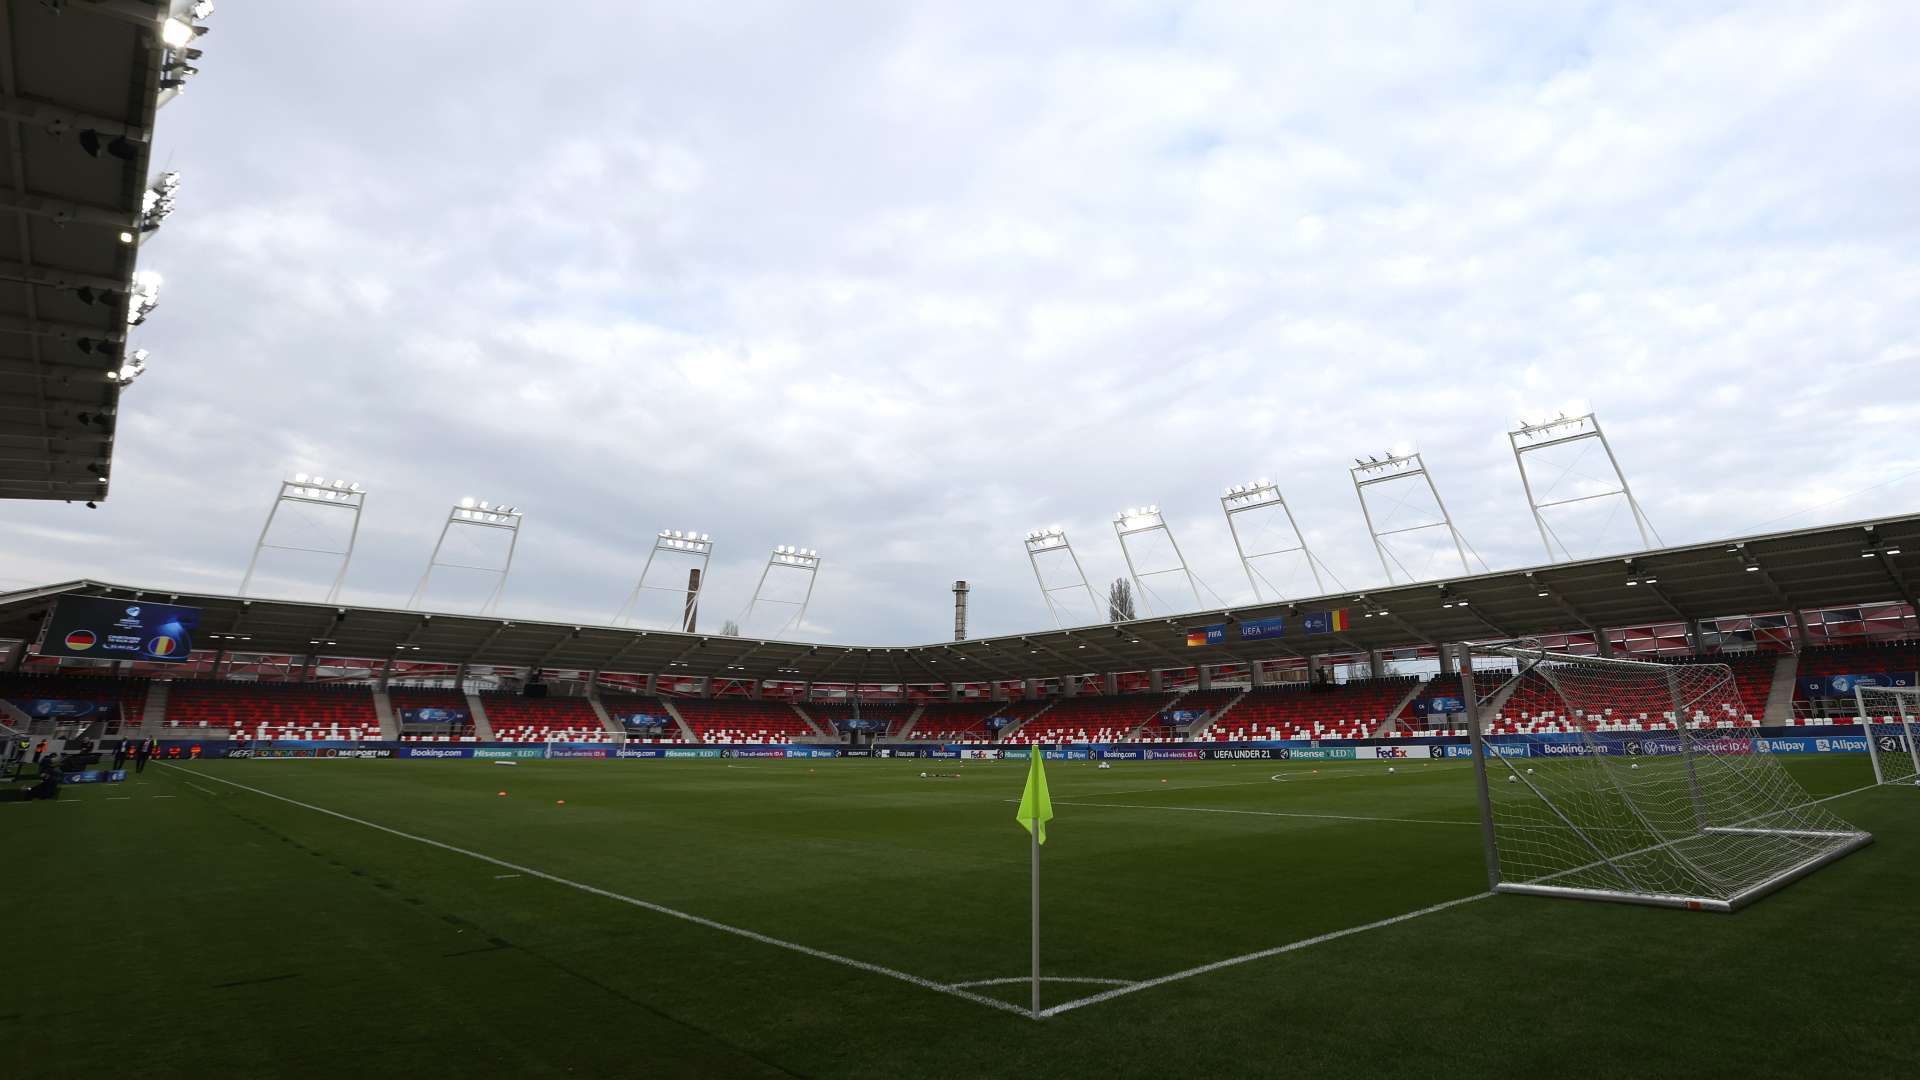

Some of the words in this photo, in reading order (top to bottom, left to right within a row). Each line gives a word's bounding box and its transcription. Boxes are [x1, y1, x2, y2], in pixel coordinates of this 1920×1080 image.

[1208, 630, 1222, 638] FIFA
[1242, 627, 1261, 635] UEFA
[1660, 744, 1677, 752] The
[1729, 742, 1750, 751] ID.4
[1771, 740, 1805, 752] Alipay
[1831, 739, 1867, 751] Alipay
[410, 749, 462, 757] Booking.com
[474, 749, 512, 757] Hisense
[615, 750, 656, 758] Booking.com
[665, 750, 696, 758] Hisense
[1104, 751, 1136, 759] Booking.com
[1213, 750, 1233, 759] UEFA
[1234, 750, 1259, 759] UNDER
[1261, 749, 1271, 758] 21
[1290, 749, 1325, 758] Hisense
[1376, 747, 1407, 758] FedEx
[1500, 746, 1525, 756] Alipay
